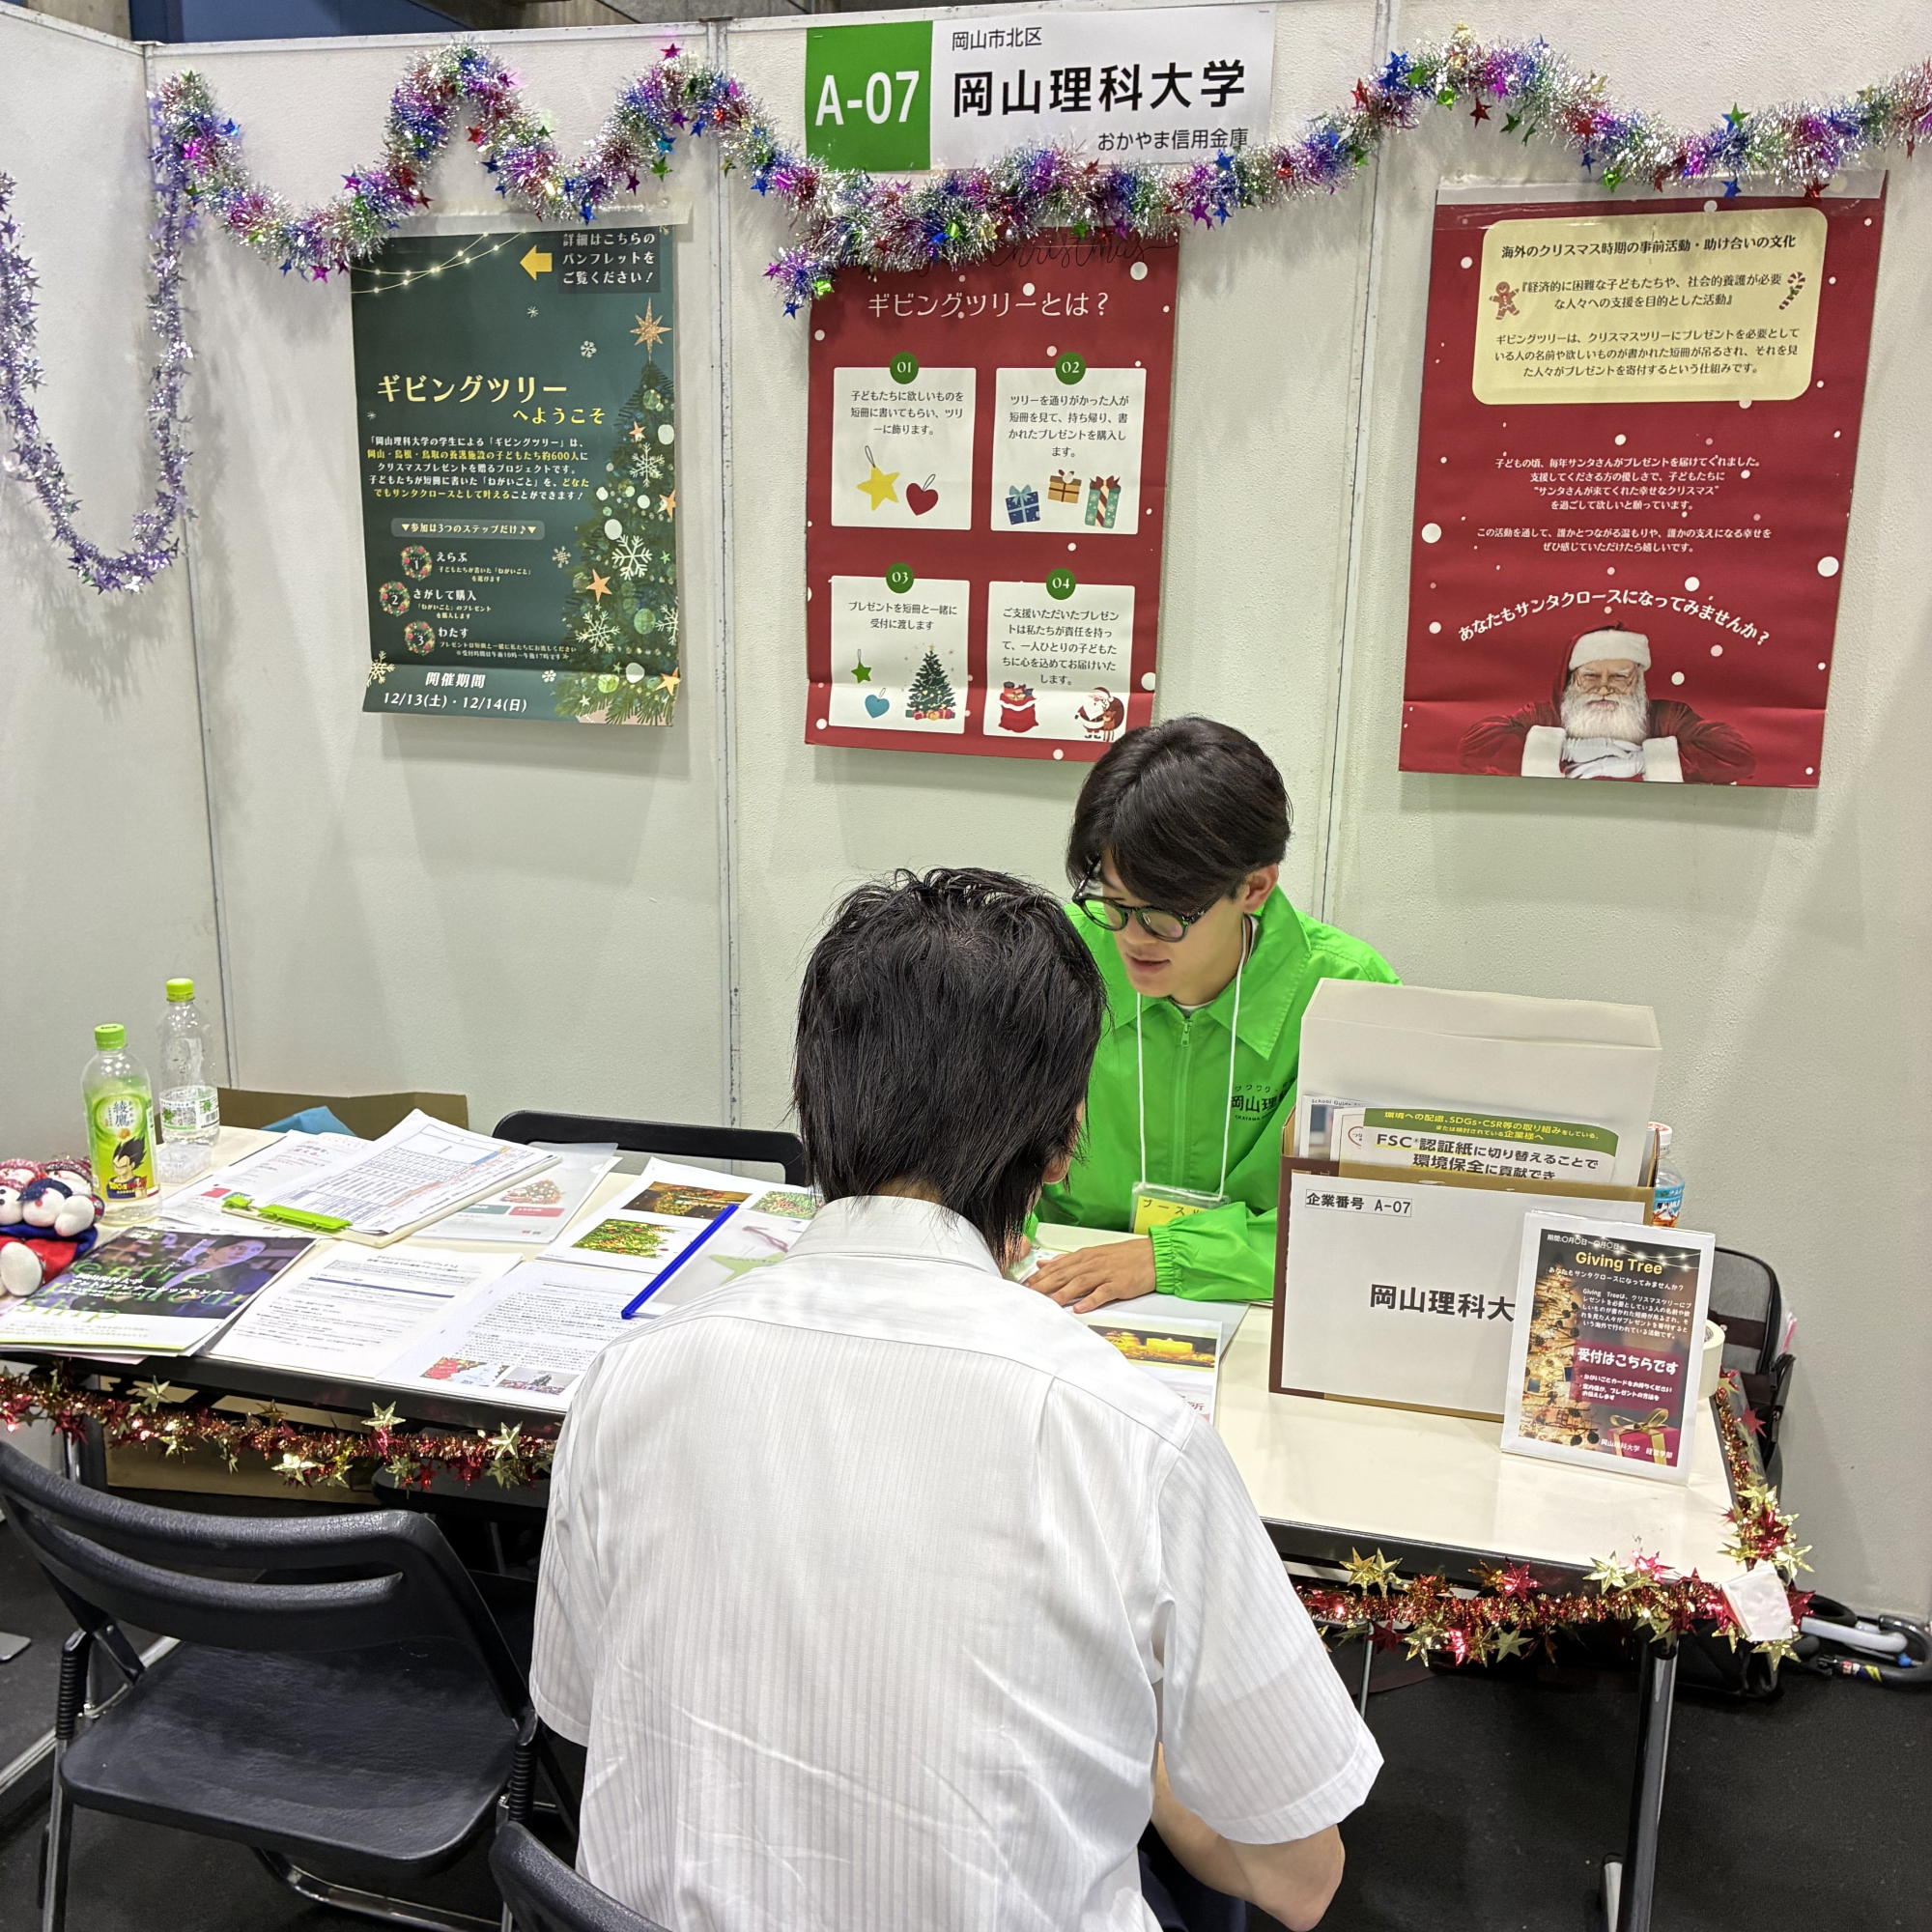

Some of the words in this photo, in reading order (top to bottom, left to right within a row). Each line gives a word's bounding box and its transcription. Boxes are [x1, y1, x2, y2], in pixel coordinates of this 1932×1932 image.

[952, 27, 1042, 51] 岡山市北区
[953, 59, 1246, 118] 岡山理科大学
[815, 70, 920, 127] A-07
[1097, 128, 1249, 151] おかやま信用金庫
[562, 232, 655, 246] 詳細はこちらの
[1501, 235, 1797, 260] 海外のクリスマス時期の事前活動・助け合いの文化
[562, 251, 655, 265] パンフレットを
[563, 270, 654, 285] ご覧ください！
[1520, 272, 1782, 294] 『経済的に困難な子どもたちや、社会的養護が必要
[868, 292, 1108, 318] ギビングツリーとは？
[1553, 294, 1733, 310] な人々への支援を目的とした活動』
[1495, 327, 1800, 346] ギビングツリーは、クリスマスツリーにプレゼントを必要として
[1494, 344, 1798, 362] いる人の名前や欲しいものが書かれた短冊が吊るされ、それを見
[896, 361, 912, 373] 01
[1062, 361, 1080, 374] 02
[1522, 362, 1759, 378] た人々がプレゼントを寄付するという仕組みです。
[377, 374, 567, 403] ギビングツリー
[851, 390, 964, 403] 子どもたちに欲しいものを
[1010, 395, 1129, 408] ツリーを通りがかった人が
[512, 408, 606, 425] へようこそ
[851, 407, 963, 419] 短冊に書いてもらい、ツリ
[1009, 412, 1128, 425] 短冊を見て、持ち帰り、書
[873, 423, 935, 436] ーに飾ります。
[1009, 429, 1127, 441] かれたプレゼントを購入し
[1051, 446, 1075, 458] ます。
[378, 463, 576, 474] クリスマスプレゼントを贈るプロジェクトです。
[1495, 455, 1760, 469] 子どもの頃、毎年サンタさんがプレゼントを届けてくれました。
[369, 475, 589, 488] 子どもたちが短冊に書いた「ねがいごと」を、どなた
[1530, 471, 1725, 483] 支援してくださる方の優しさで、子どもたちに
[1550, 498, 1693, 511] を過ごして欲しいと願っています。
[1477, 526, 1772, 540] この活動を通して、誰かとつながる温もりや、誰かの支えになる幸せを
[1543, 541, 1693, 554] ぜひ感じていただけたら嬉しいです。
[413, 559, 419, 570] 1
[437, 552, 468, 563] えらぶ
[892, 572, 909, 583] 03
[1052, 578, 1070, 590] 04
[391, 594, 399, 606] 2
[413, 589, 476, 602] さがして購入
[849, 602, 957, 616] プレゼントを短冊と一緒に
[1003, 608, 1120, 622] ご支援いただいたプレゼン
[1458, 588, 1771, 646] あなたもサンタクロースになってみませんか？
[869, 618, 934, 631] 受付に渡します
[1009, 624, 1113, 639] トは私たちが責任を持っ
[438, 627, 469, 639] わたす
[417, 635, 425, 646] 3
[1002, 640, 1118, 656] て、一人ひとりの子どもた
[1002, 657, 1117, 671] ちに心を込めてお届けいた
[425, 671, 486, 689] 開催期間
[1040, 673, 1073, 686] します。
[384, 692, 527, 713] 12/13(土)・12/14(日)
[1435, 1125, 1545, 1141] または検討されている企業様へ
[1306, 1192, 1365, 1211] 企業番号
[1374, 1199, 1411, 1215] A-07
[1576, 1251, 1624, 1272] Giving
[1627, 1258, 1662, 1275] Tree
[1548, 1266, 1684, 1292] あなたもサンタクロースになってみませんか？
[1582, 1288, 1602, 1297] Giving
[1370, 1283, 1517, 1322] 岡山理科大
[1577, 1348, 1679, 1376] 受付はこちらです
